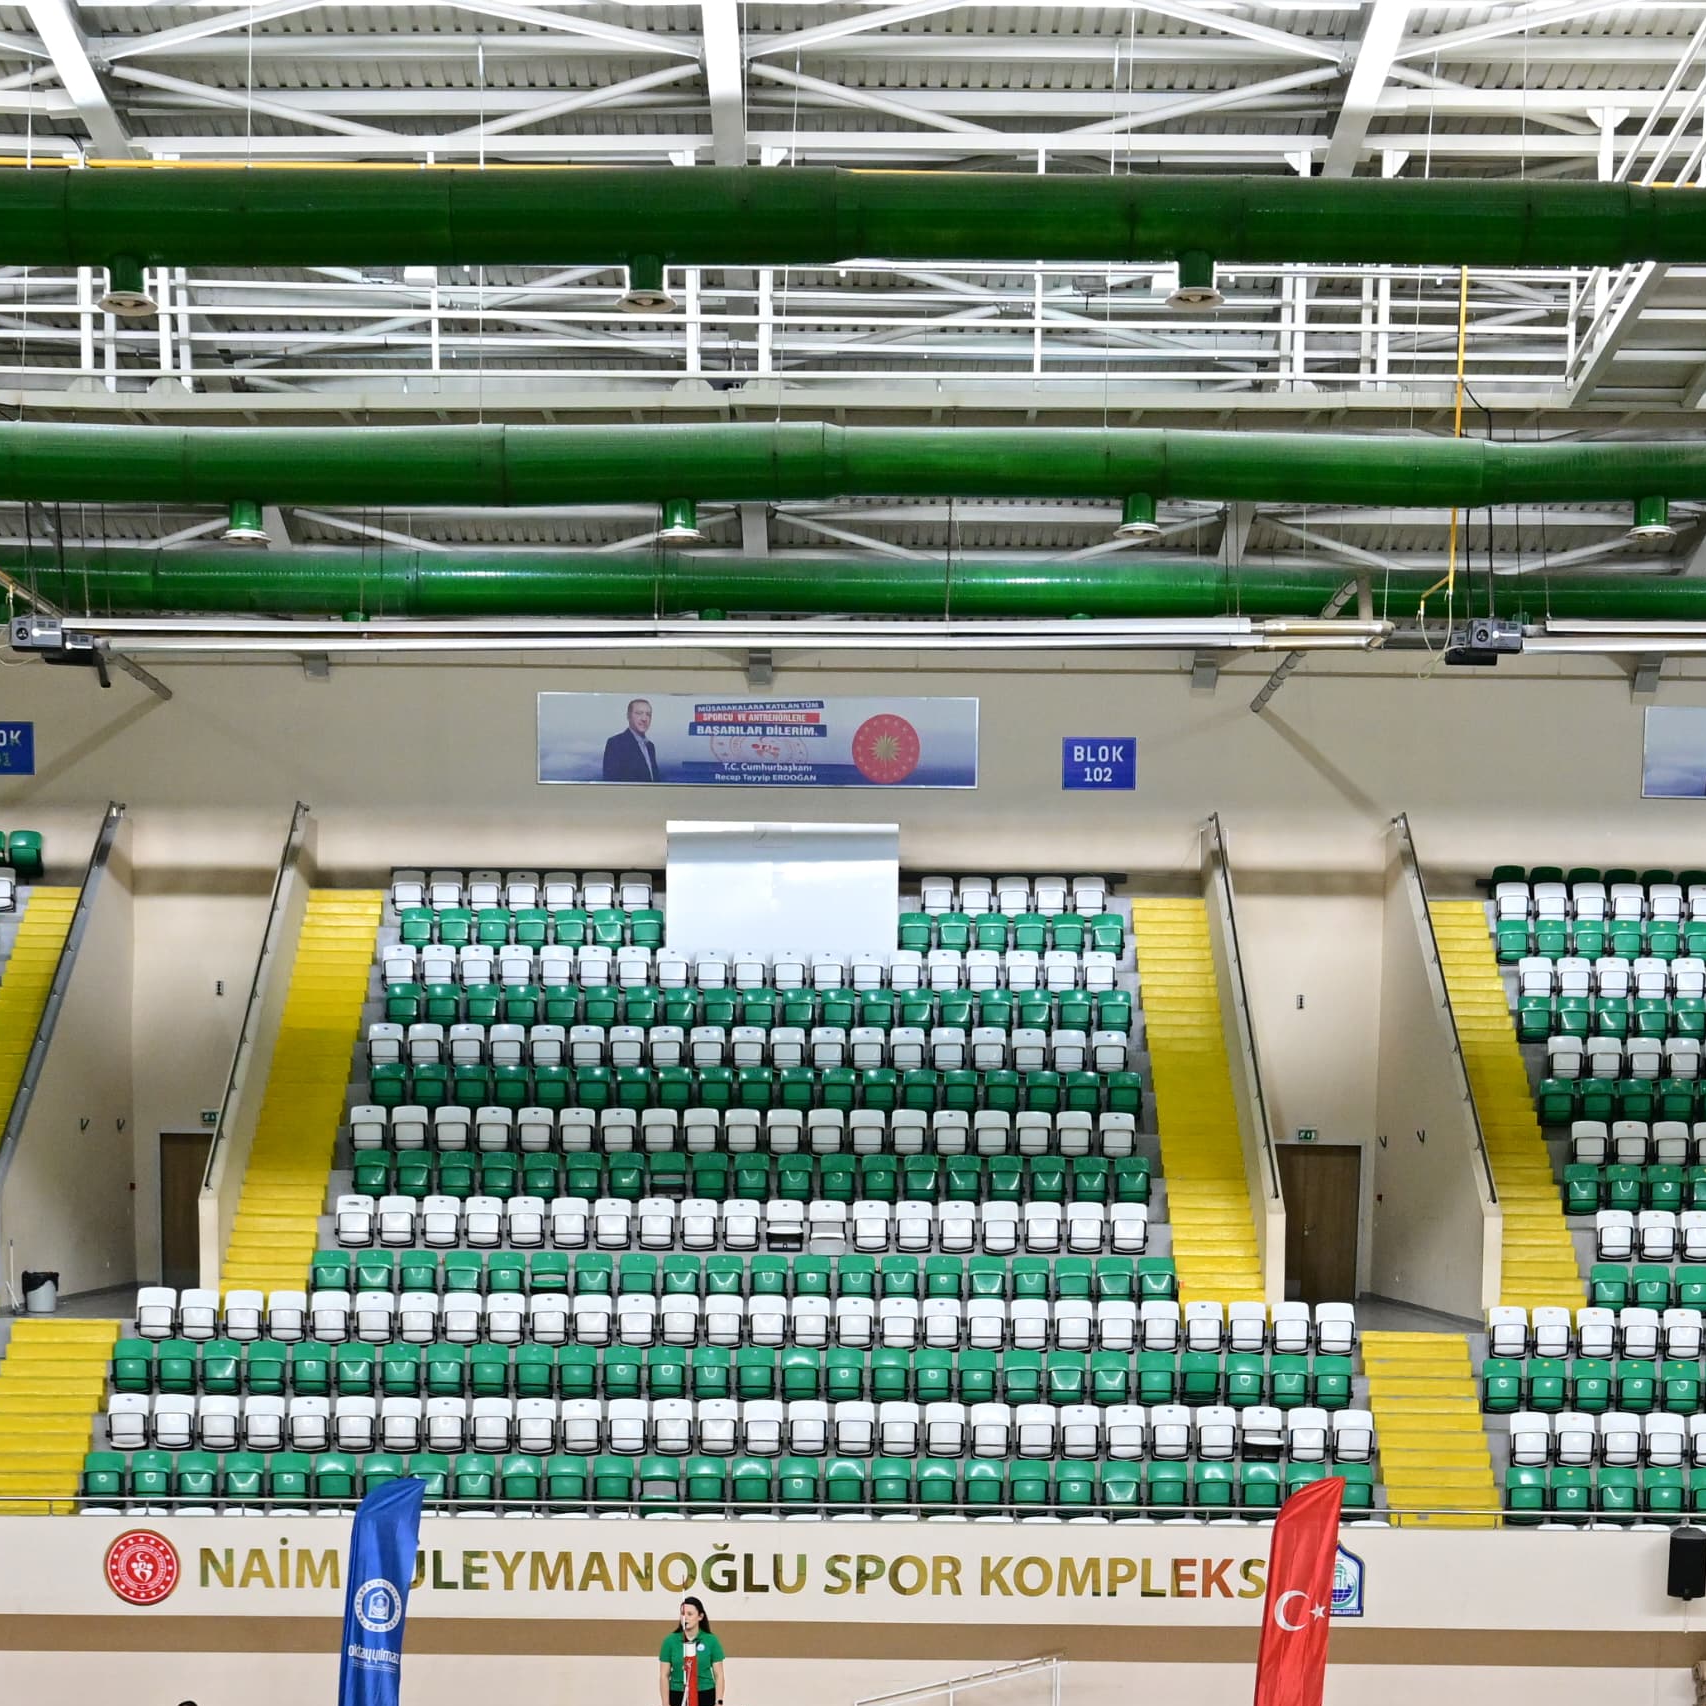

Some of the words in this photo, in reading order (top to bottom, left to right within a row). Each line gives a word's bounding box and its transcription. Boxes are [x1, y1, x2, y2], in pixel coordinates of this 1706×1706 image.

[702, 712, 734, 722] SPORCU
[737, 713, 747, 722] VE
[749, 713, 806, 722] ANTRENÖRLERE
[696, 725, 763, 736] BAŞARILAR
[766, 723, 819, 737] DİLERİM.
[1073, 745, 1124, 762] BLOK
[723, 763, 740, 772] T.C.
[740, 763, 813, 774] Cumhurbaşkanı
[1084, 766, 1113, 783] 102
[714, 773, 741, 783] Recep
[742, 773, 771, 783] Tayyip
[772, 773, 817, 782] ERDOĞAN
[200, 1537, 341, 1588] NAİM
[824, 1553, 962, 1596] SPOR
[980, 1555, 1266, 1599] KOMPLEKS
